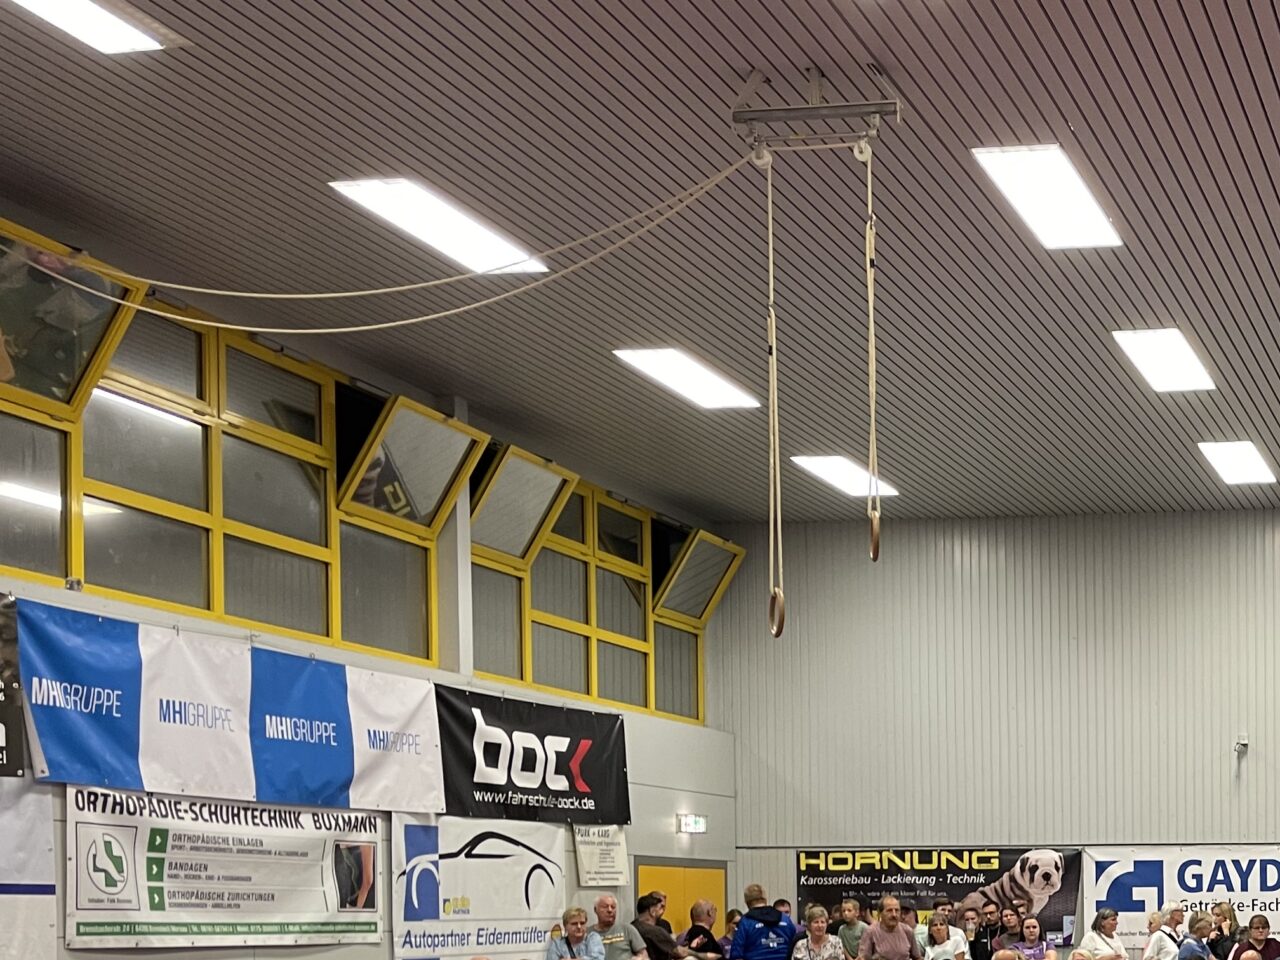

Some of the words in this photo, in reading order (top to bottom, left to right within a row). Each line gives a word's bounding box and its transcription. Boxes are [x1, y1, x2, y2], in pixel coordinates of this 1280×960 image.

[32, 677, 122, 717] MHIGRUPPE
[159, 698, 235, 732] MHIGRUPPE
[265, 714, 338, 746] MHIGRUPPE
[473, 790, 596, 810] www.fahrschule-bock.de
[74, 790, 305, 830] ORTHOPÄDIE-SCHUHTECHNIK
[312, 812, 377, 834] BUXMANN
[172, 833, 230, 847] ORTHOPÄDISCHE
[232, 838, 264, 848] EINLAGEN
[167, 861, 208, 872] BANDAGEN
[799, 850, 1000, 871] HORNUNG
[800, 874, 870, 886] Karosseriebau
[881, 874, 936, 887] Lackierung
[946, 874, 986, 885] Technik
[167, 890, 225, 901] ORTHOPÄDISCHE
[402, 929, 471, 953] Autopartner
[476, 927, 550, 946] Eidenmüller
